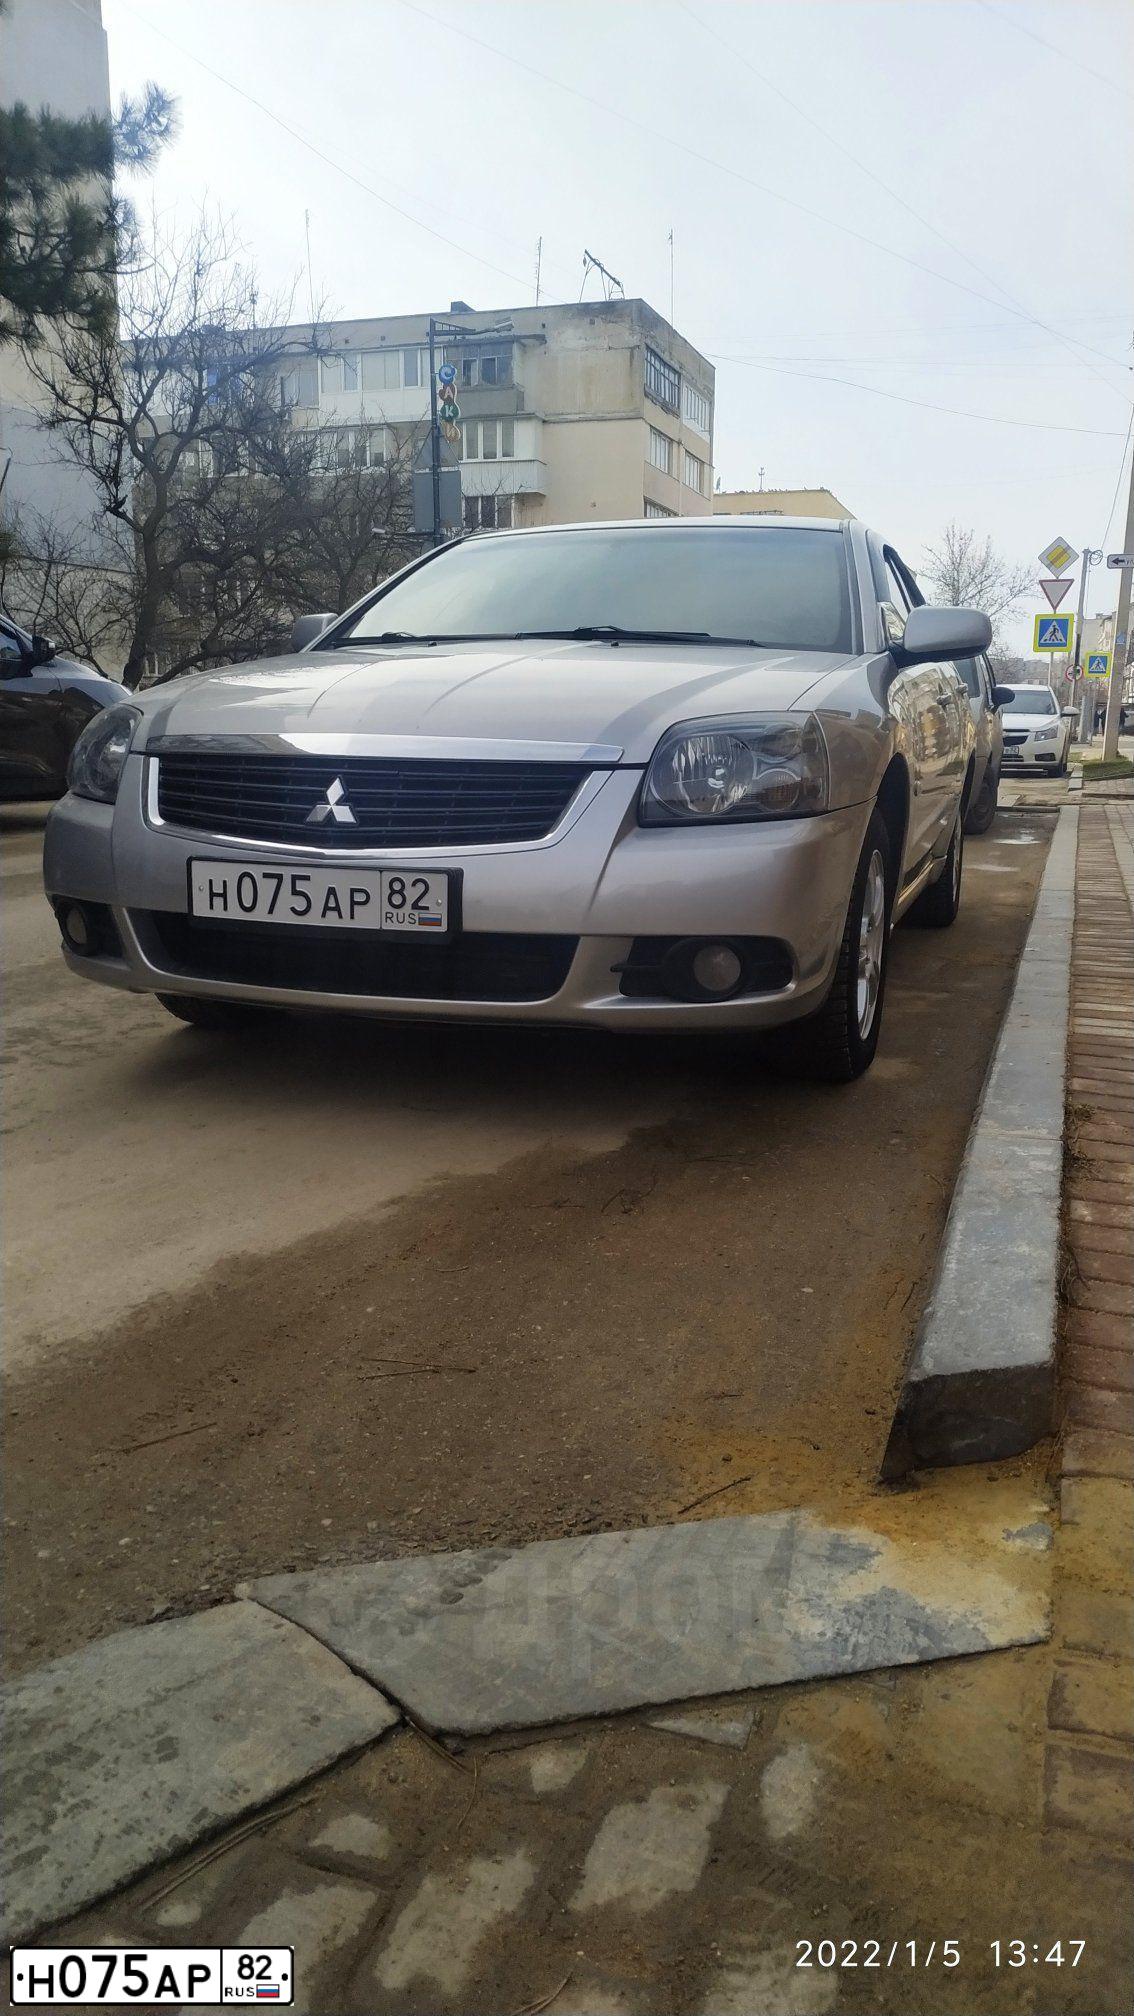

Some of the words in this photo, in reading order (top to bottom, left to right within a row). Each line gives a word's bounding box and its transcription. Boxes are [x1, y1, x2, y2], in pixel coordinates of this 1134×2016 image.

[208, 871, 371, 919] Н075АР
[387, 876, 430, 911] 82
[385, 911, 417, 925] RUS
